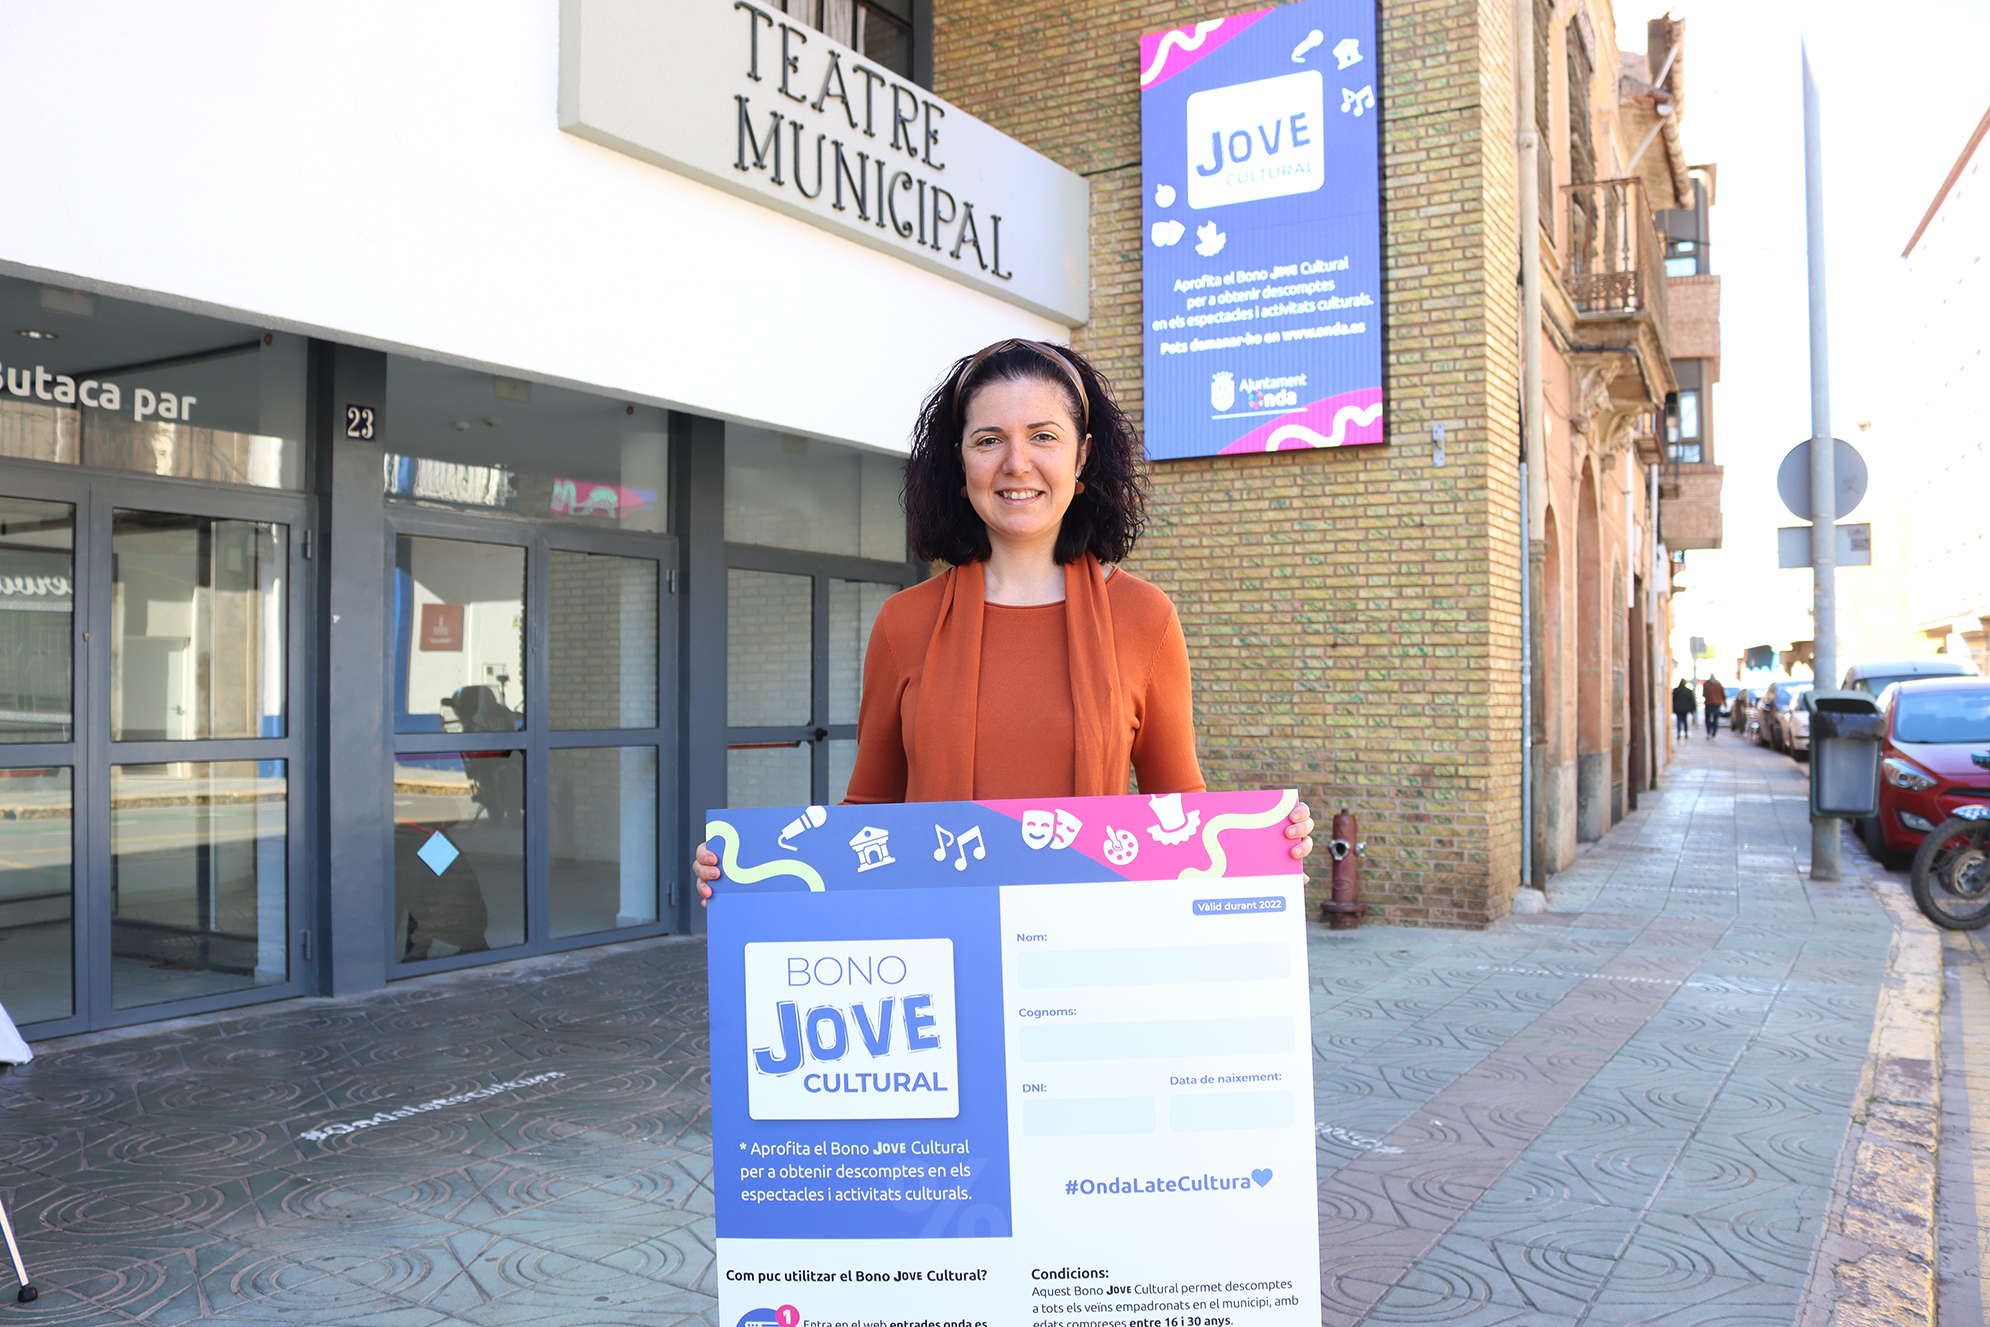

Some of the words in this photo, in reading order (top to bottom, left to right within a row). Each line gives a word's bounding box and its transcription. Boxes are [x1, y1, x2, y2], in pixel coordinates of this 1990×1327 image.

[734, 1, 946, 171] TEATRE
[1195, 111, 1311, 178] JOVE
[1225, 161, 1316, 187] CULTURAL
[733, 94, 1013, 280] MUNICIPAL
[1173, 273, 1222, 294] Aprofita
[1223, 270, 1235, 286] el
[1236, 269, 1268, 284] Bono
[1300, 255, 1349, 276] Cultural
[1186, 296, 1208, 312] per
[1208, 294, 1217, 307] a
[1217, 287, 1261, 305] obtenir
[1262, 279, 1335, 299] descomptes
[1152, 319, 1168, 331] en
[1168, 314, 1186, 329] els
[1186, 307, 1254, 328] espectacles
[1255, 304, 1260, 319] i
[1261, 296, 1317, 318] activitats
[1317, 291, 1374, 311] culturals.
[1160, 340, 1188, 355] Pots
[1189, 331, 1263, 352] demanar-ho
[1263, 331, 1281, 344] en
[1281, 321, 1367, 342] www.onda.es
[0, 362, 121, 411] utaca
[134, 388, 197, 422] par
[1239, 373, 1308, 392] Ajuntament
[346, 407, 375, 441] 23
[1224, 901, 1257, 911] durant
[1259, 899, 1282, 909] 2022
[1016, 932, 1047, 943] Nom:
[788, 955, 907, 986] BONO
[1018, 1006, 1077, 1019] Cognoms:
[752, 993, 941, 1077] JOVE
[803, 1072, 948, 1093] CULTURAL
[1170, 1075, 1197, 1085] Data
[1200, 1074, 1215, 1084] de
[1217, 1071, 1282, 1083] naixement:
[1022, 1083, 1047, 1093] DNI:
[750, 1141, 810, 1158] Aprofita
[814, 1141, 827, 1155] el
[831, 1142, 869, 1155] Bono
[873, 1141, 907, 1155] JOVE
[911, 1139, 970, 1154] Cultural
[740, 1167, 764, 1181] per
[768, 1168, 775, 1178] a
[779, 1164, 832, 1178] obtenir
[836, 1164, 924, 1181] descomptes
[928, 1166, 946, 1177] en
[950, 1162, 971, 1177] els
[1065, 1174, 1251, 1196] #OndaLateCultura
[741, 1187, 824, 1204] espectacles
[828, 1187, 832, 1201] i
[835, 1187, 901, 1201] activitats
[905, 1186, 972, 1201] culturals.
[726, 1270, 754, 1281] Com
[758, 1273, 781, 1284] puc
[784, 1269, 836, 1282] utilitzar
[840, 1270, 852, 1282] el
[856, 1271, 890, 1282] Bono
[894, 1271, 922, 1282] JOVE
[927, 1269, 987, 1281] Cultural?
[1031, 1267, 1109, 1280] Condicions:
[1031, 1286, 1071, 1299] Aquest
[1074, 1285, 1104, 1296] Bono
[1106, 1285, 1132, 1296] JOVE
[1134, 1283, 1178, 1295] Cultural
[1181, 1282, 1223, 1295] permet
[1225, 1279, 1293, 1292] descomptes
[1032, 1305, 1039, 1314] a
[1041, 1303, 1064, 1314] tots
[1066, 1302, 1082, 1313] els
[1084, 1301, 1113, 1312] veïns
[1115, 1300, 1190, 1313] empadronats
[1192, 1301, 1207, 1310] en
[1209, 1298, 1220, 1309] el
[1222, 1297, 1272, 1309] municipi,
[1274, 1295, 1299, 1306] amb
[782, 1308, 792, 1325] 1
[803, 1319, 832, 1327] Entra
[851, 1319, 861, 1327] el
[863, 1319, 887, 1327] web
[1032, 1319, 1063, 1327] edats
[1129, 1318, 1161, 1327] entre
[1164, 1317, 1178, 1327] 16
[1181, 1316, 1184, 1326] i
[1187, 1316, 1201, 1326] 30
[1204, 1317, 1234, 1327] anys.
